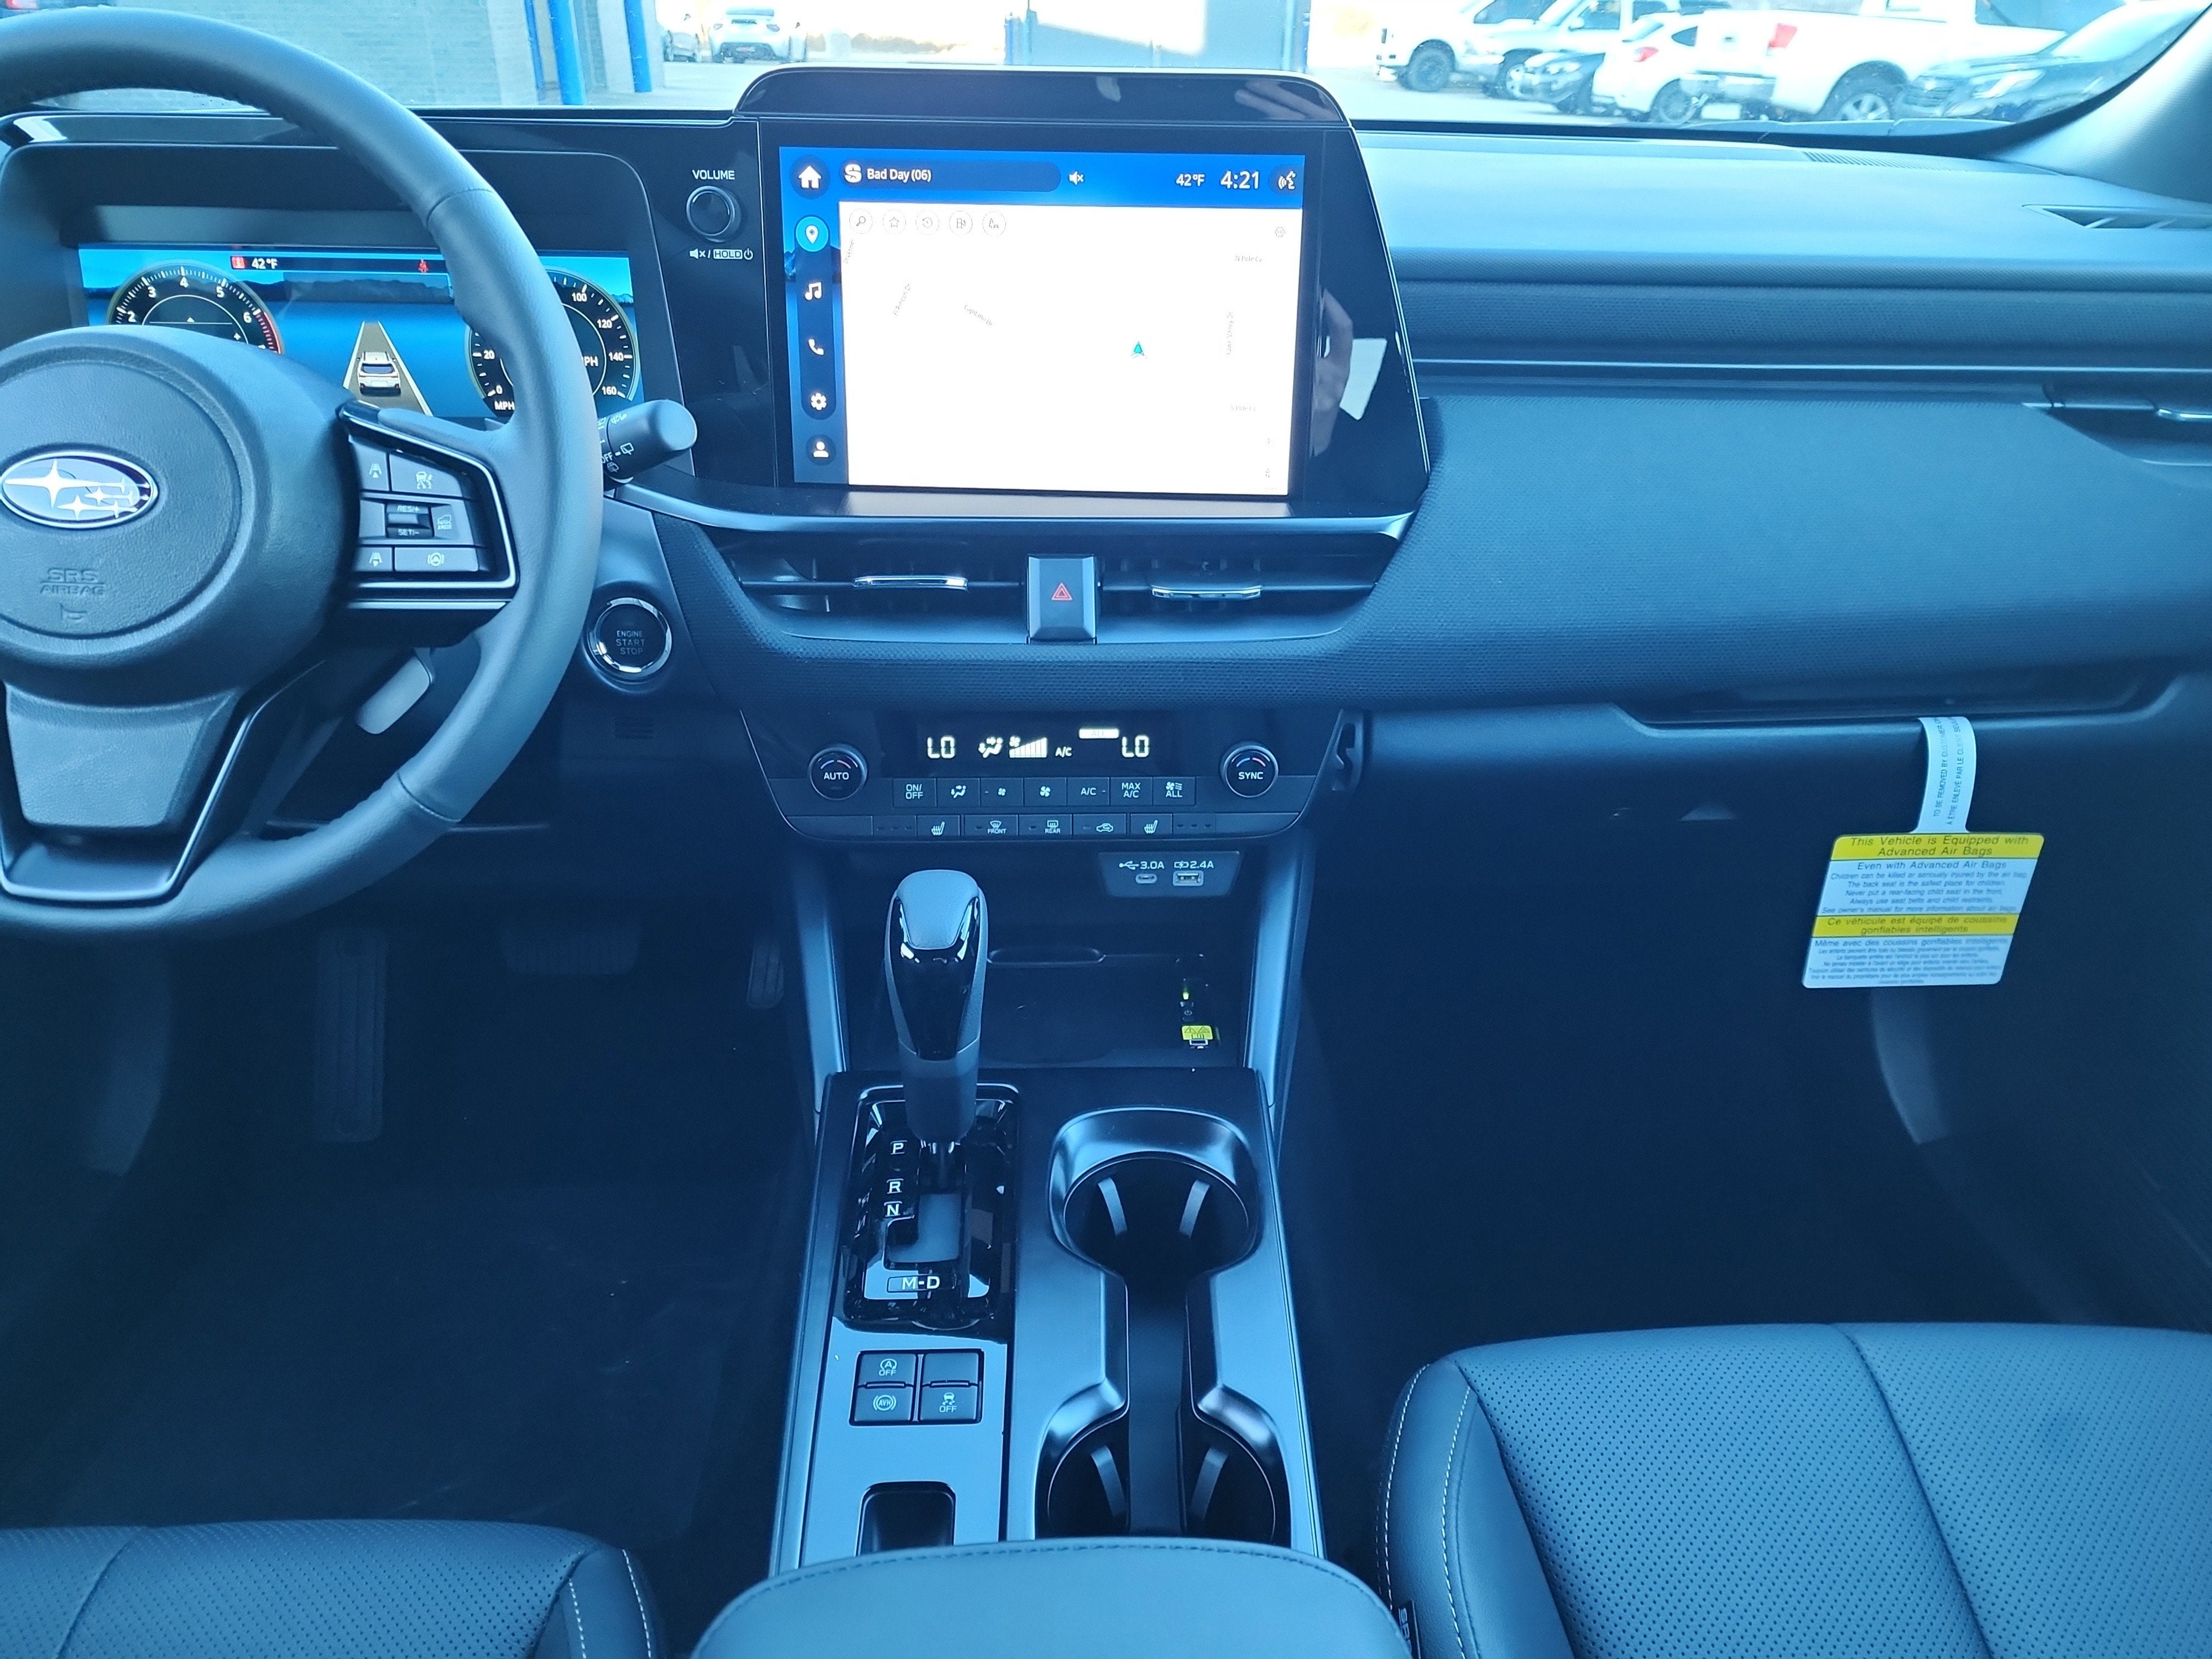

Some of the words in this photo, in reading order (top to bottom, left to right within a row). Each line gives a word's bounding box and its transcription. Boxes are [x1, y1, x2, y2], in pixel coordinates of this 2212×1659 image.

[692, 170, 735, 180] VOLUME
[867, 168, 887, 180] Bad
[890, 169, 910, 183] Day
[911, 169, 931, 182] (06)
[1220, 170, 1259, 189] 4:21
[714, 250, 742, 258] HOLD
[180, 276, 189, 288] 4
[148, 286, 156, 298] 3
[216, 286, 225, 298] 5
[572, 293, 587, 302] 100
[127, 311, 137, 322] 2
[243, 312, 252, 323] 6
[597, 319, 612, 328] 120
[483, 349, 495, 359] 20
[608, 352, 624, 361] 140
[582, 356, 599, 366] PH
[496, 385, 503, 394] 0
[602, 386, 617, 395] 160
[494, 400, 515, 410] MPH
[47, 567, 98, 582] SRS
[40, 585, 103, 595] AIRBAG
[927, 736, 956, 759] LO
[1121, 735, 1150, 758] LO
[1055, 747, 1072, 758] A/C
[823, 771, 849, 780] AUTO
[1238, 771, 1264, 780] SYNC
[1938, 770, 1948, 799] REMOVED
[1850, 837, 1874, 846] This
[1881, 837, 1922, 846] Vehicle
[1927, 836, 1936, 845] is
[1943, 836, 2000, 846] Equipped
[1877, 847, 1936, 856] Advanced
[1963, 847, 1992, 857] Bags
[1140, 861, 1164, 869] 3.0A
[1190, 860, 1214, 869] 2.4A
[1981, 861, 2007, 870] Bags
[893, 1142, 904, 1154] P
[889, 1181, 901, 1193] R
[886, 1204, 900, 1215] N
[901, 1276, 940, 1290] M-D
